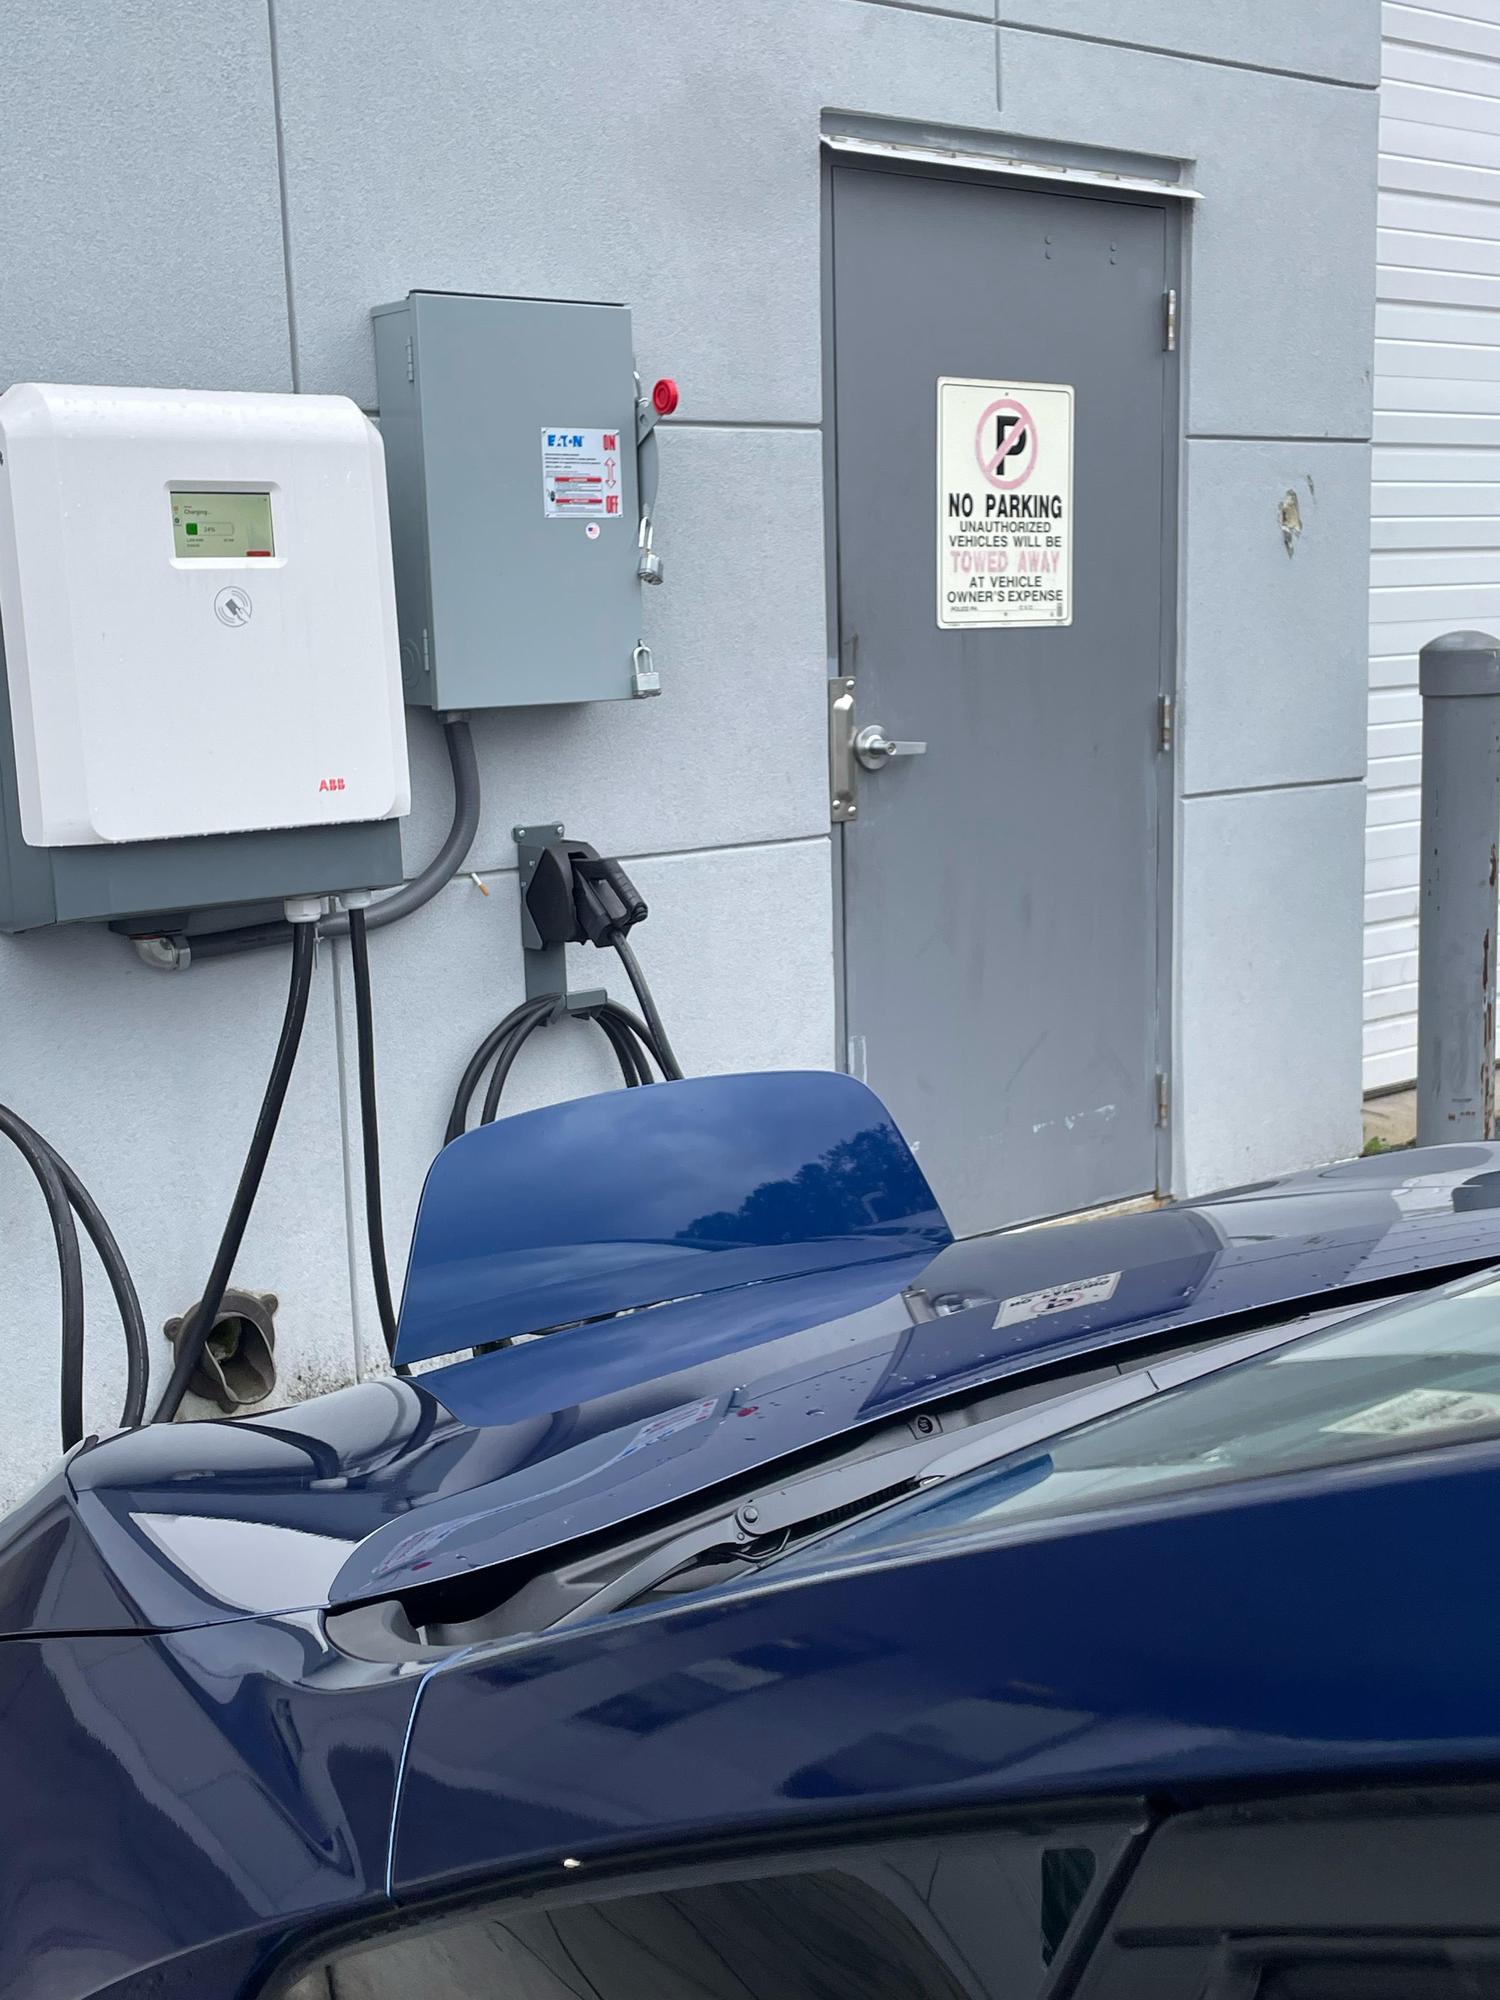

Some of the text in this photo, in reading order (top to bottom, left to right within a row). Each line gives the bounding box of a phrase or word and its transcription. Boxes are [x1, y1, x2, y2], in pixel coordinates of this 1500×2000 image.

[948, 493, 1062, 518] NO PARKING
[960, 521, 1051, 533] UNAUTHORIZED
[949, 535, 1062, 547] VEHICLES WILL BE
[950, 551, 1060, 573] TOWED AWAY
[969, 576, 1042, 588] AT VEHICLE
[947, 590, 1063, 603] OWNER'S EXPENSE
[319, 778, 346, 792] ABB
